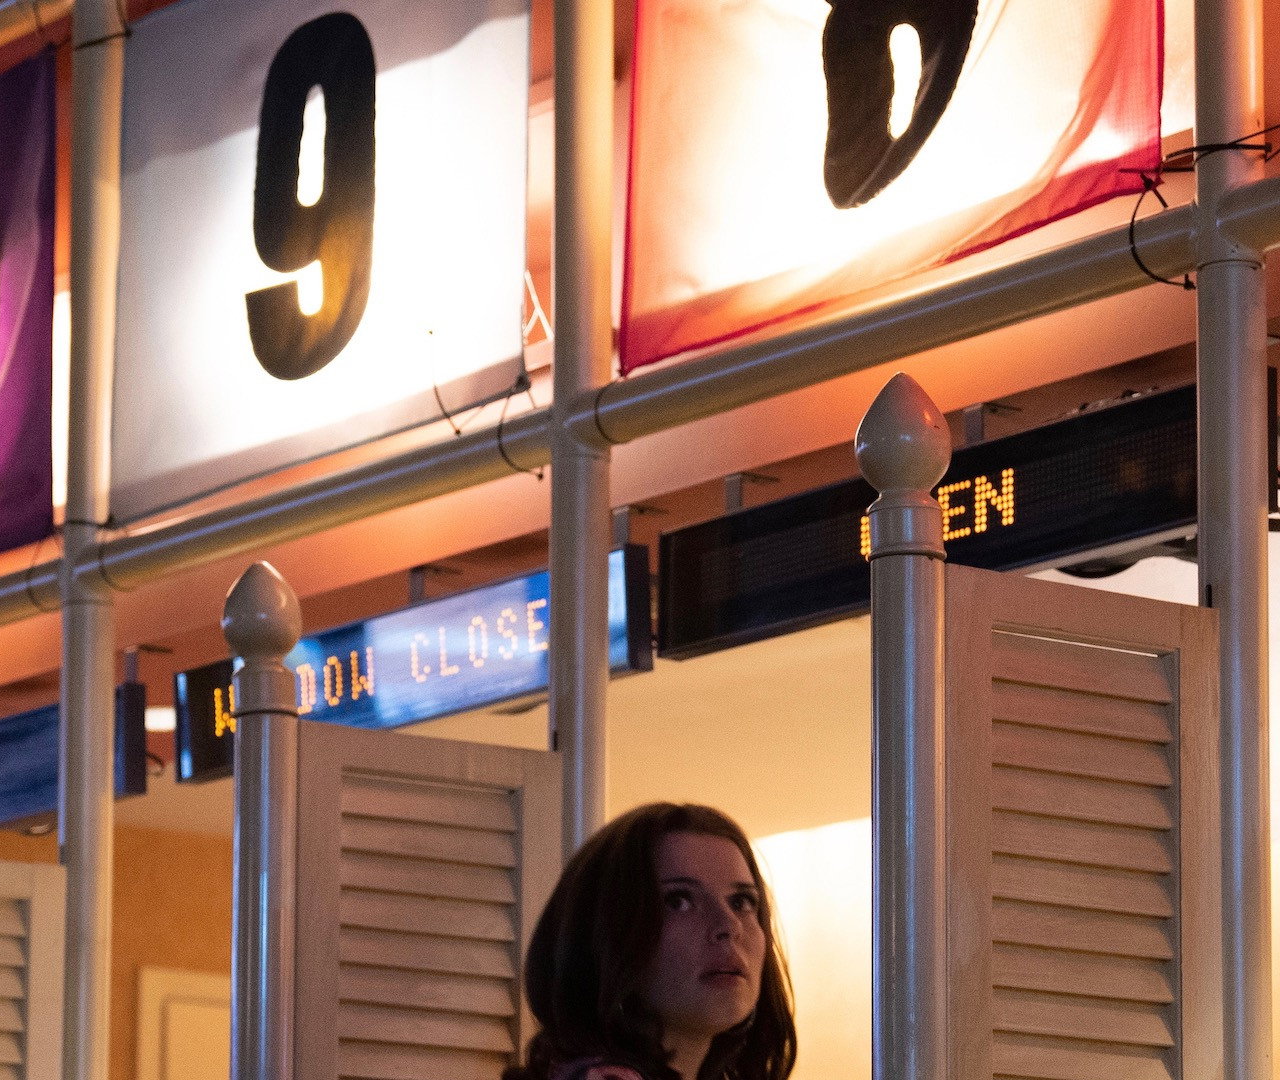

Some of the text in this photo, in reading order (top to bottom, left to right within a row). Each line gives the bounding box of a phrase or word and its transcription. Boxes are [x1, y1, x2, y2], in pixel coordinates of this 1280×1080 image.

[244, 11, 377, 381] 9
[214, 599, 549, 737] WDOW CLOSE
